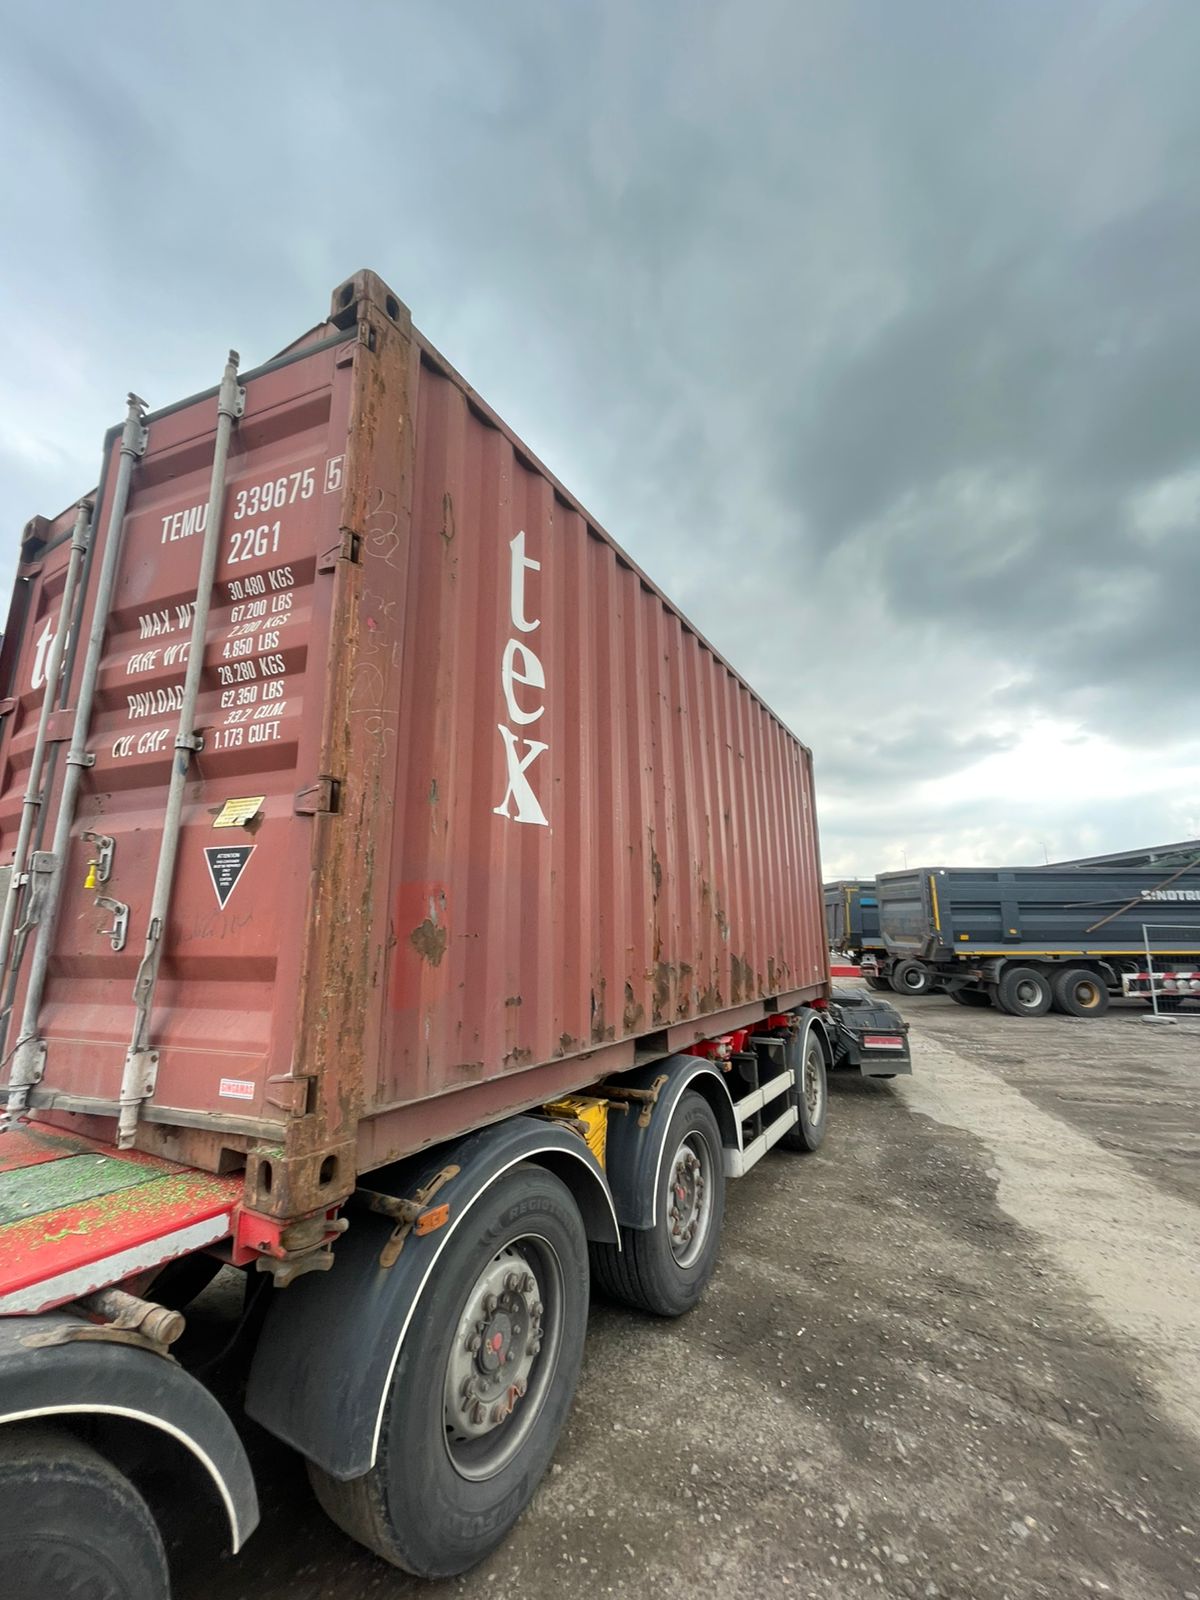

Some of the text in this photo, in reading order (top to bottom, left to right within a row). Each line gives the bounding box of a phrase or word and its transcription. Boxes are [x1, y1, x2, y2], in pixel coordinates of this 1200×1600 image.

[161, 457, 343, 544] TEMU 339675 5
[227, 521, 281, 565] 22G1
[227, 566, 295, 601] 30.480 KGS
[230, 592, 293, 623] 67.200 LBS
[262, 612, 292, 630] KGS
[138, 609, 175, 640] MAX.
[222, 630, 280, 659] 4.850 LBS
[126, 648, 162, 675] TARE
[217, 654, 286, 686] 28.280 KGS
[262, 680, 285, 700] LBS
[493, 530, 549, 826] tex
[126, 684, 186, 720] PAYLOAD
[223, 708, 254, 725] 33.2
[111, 728, 171, 758] CU. CAP.
[214, 727, 244, 750] 1.173
